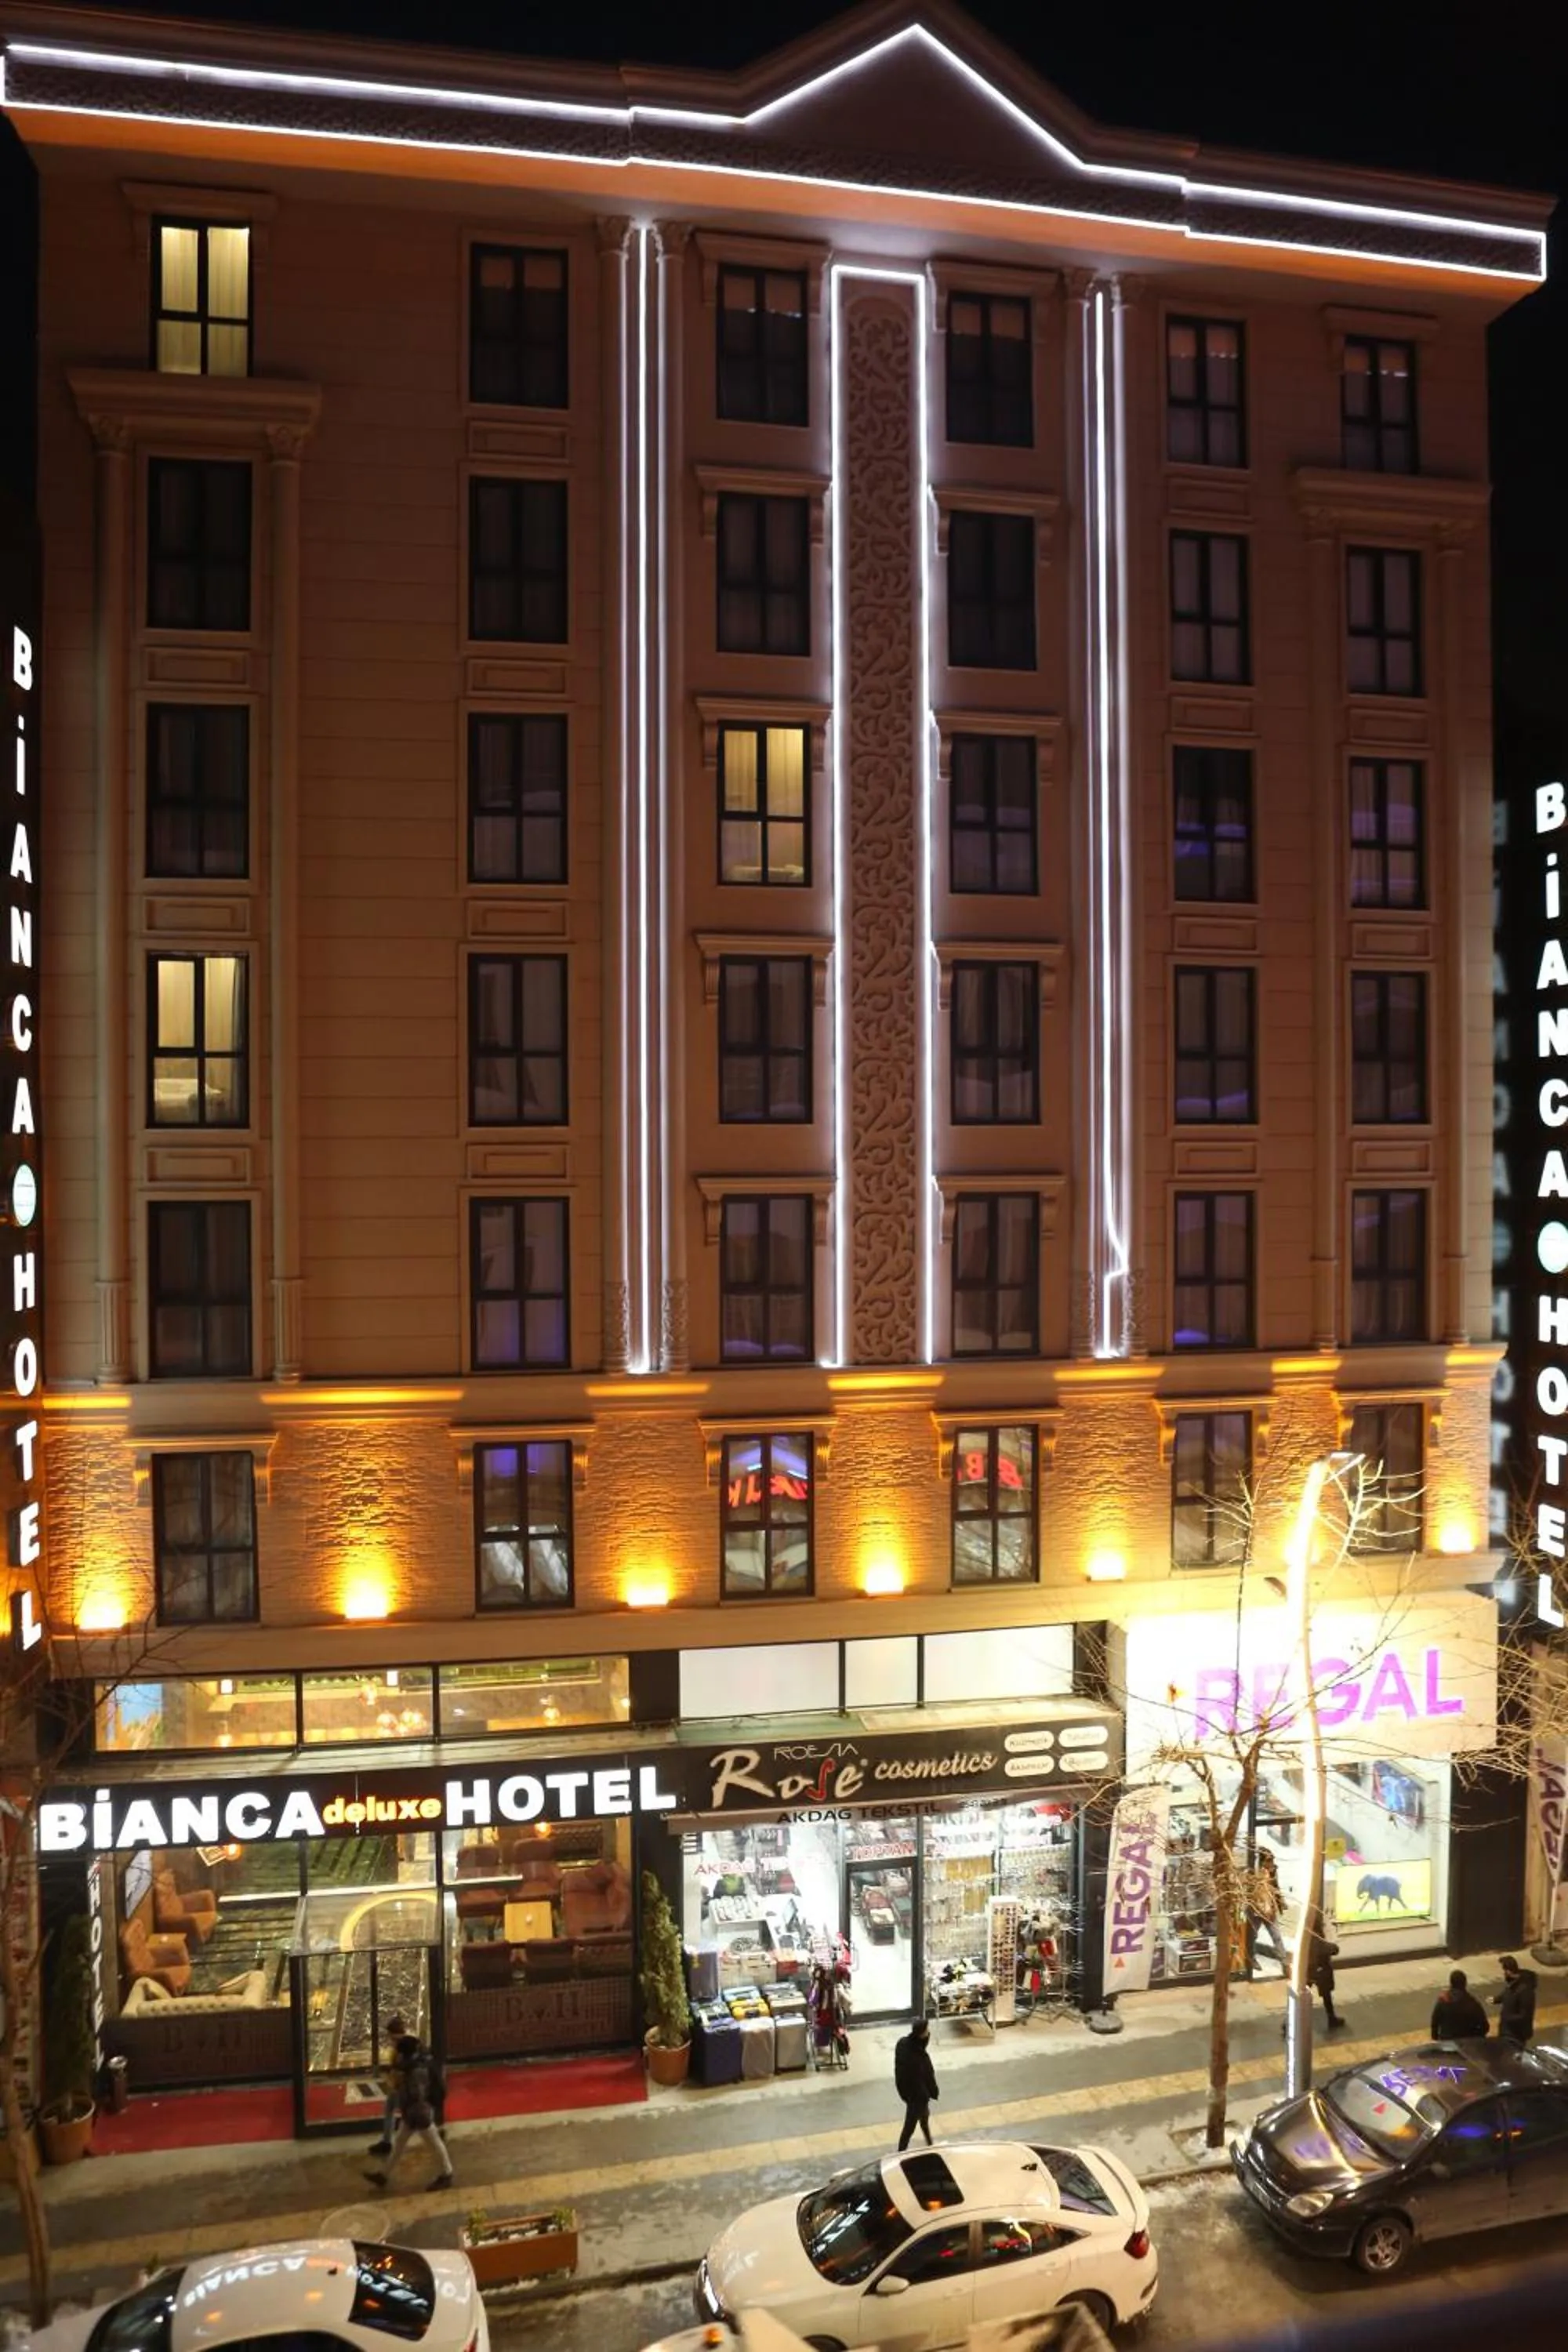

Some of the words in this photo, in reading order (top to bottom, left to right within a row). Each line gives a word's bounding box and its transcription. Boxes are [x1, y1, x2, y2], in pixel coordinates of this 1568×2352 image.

[13, 1252, 42, 1650] HOTEL
[1537, 1294, 1568, 1628] HOTEL
[1194, 1649, 1464, 1739] REGAL
[322, 1795, 442, 1825] deluxe
[445, 1766, 677, 1826] HOTEL
[710, 1748, 863, 1809] Rose
[874, 1751, 998, 1781] cosmetics
[1110, 1810, 1158, 1955] REGAL
